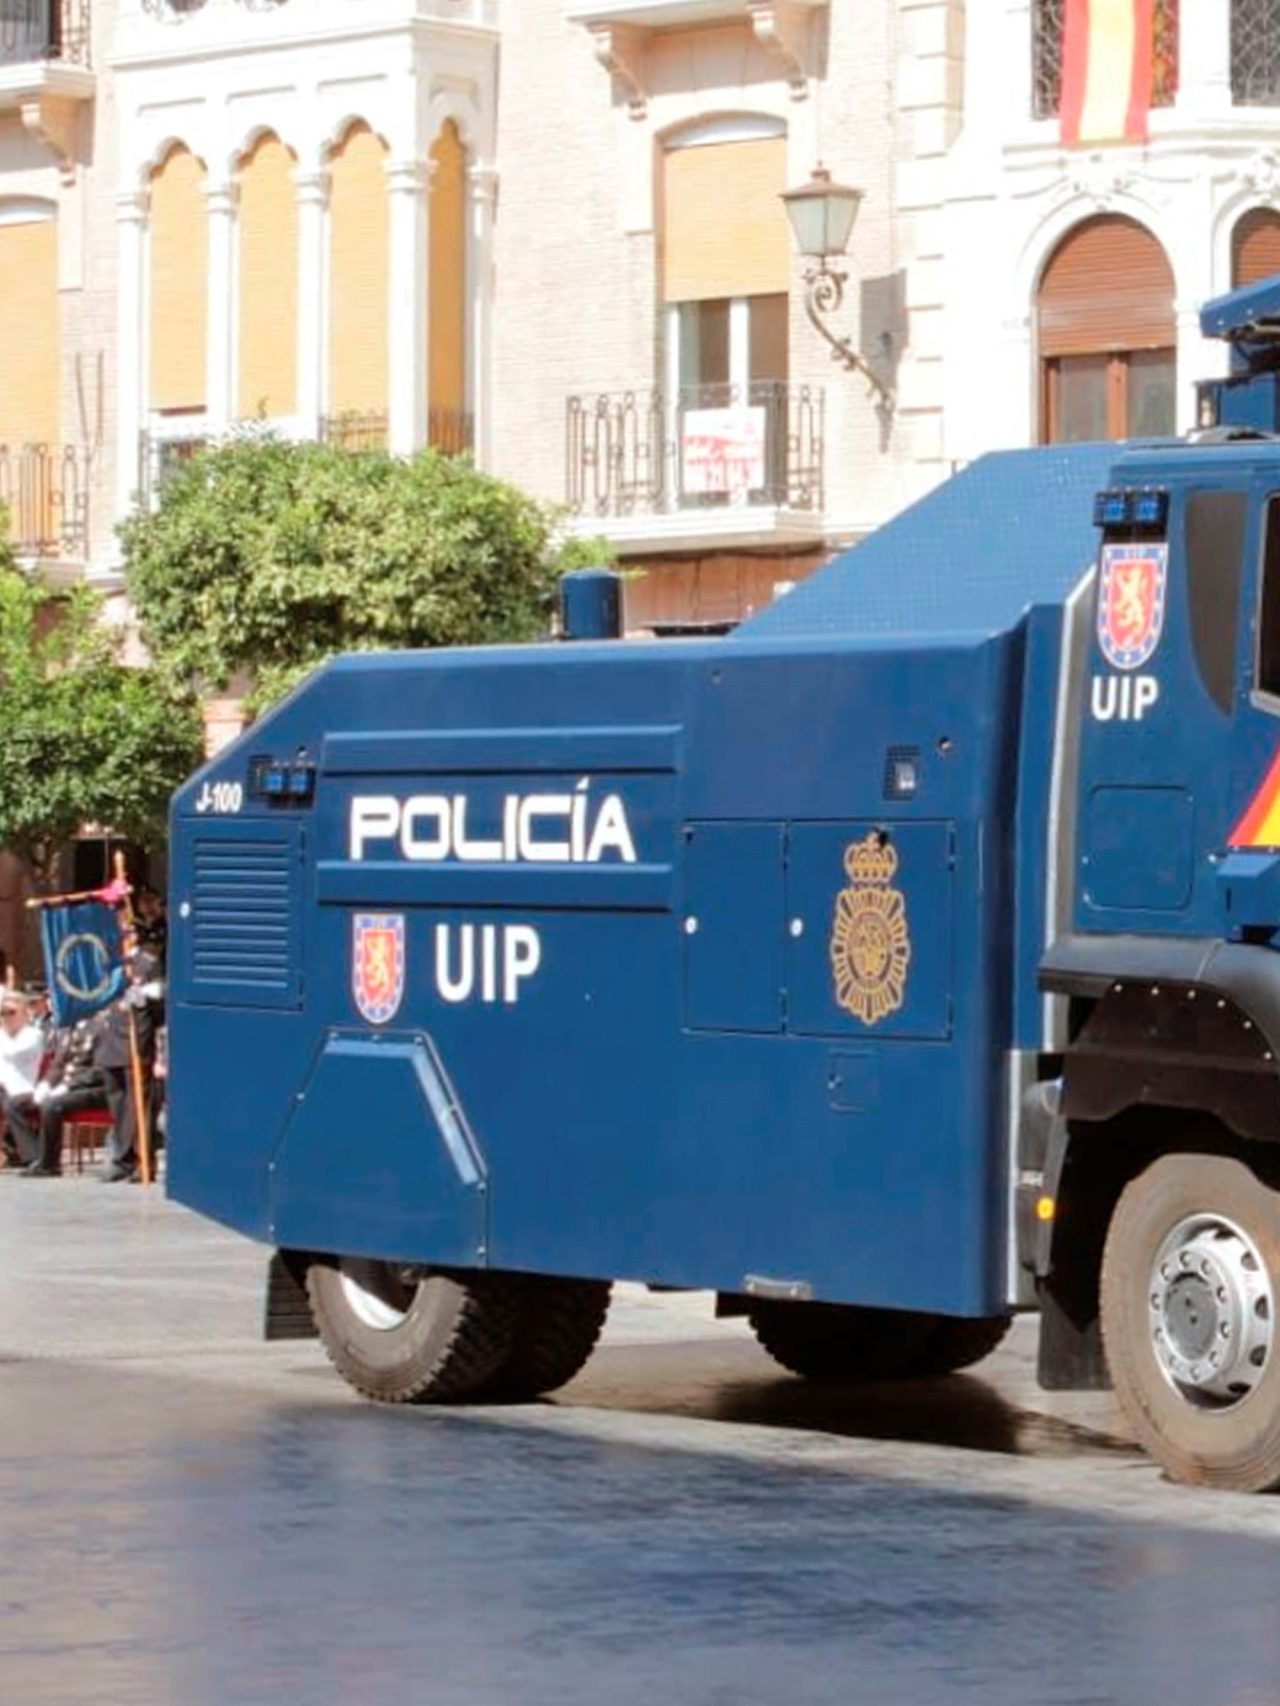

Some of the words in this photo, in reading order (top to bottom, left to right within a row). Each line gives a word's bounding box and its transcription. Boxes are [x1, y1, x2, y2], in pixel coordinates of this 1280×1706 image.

[1092, 675, 1159, 721] UIP
[349, 776, 637, 862] POLICÍA
[435, 924, 541, 1002] UIP
